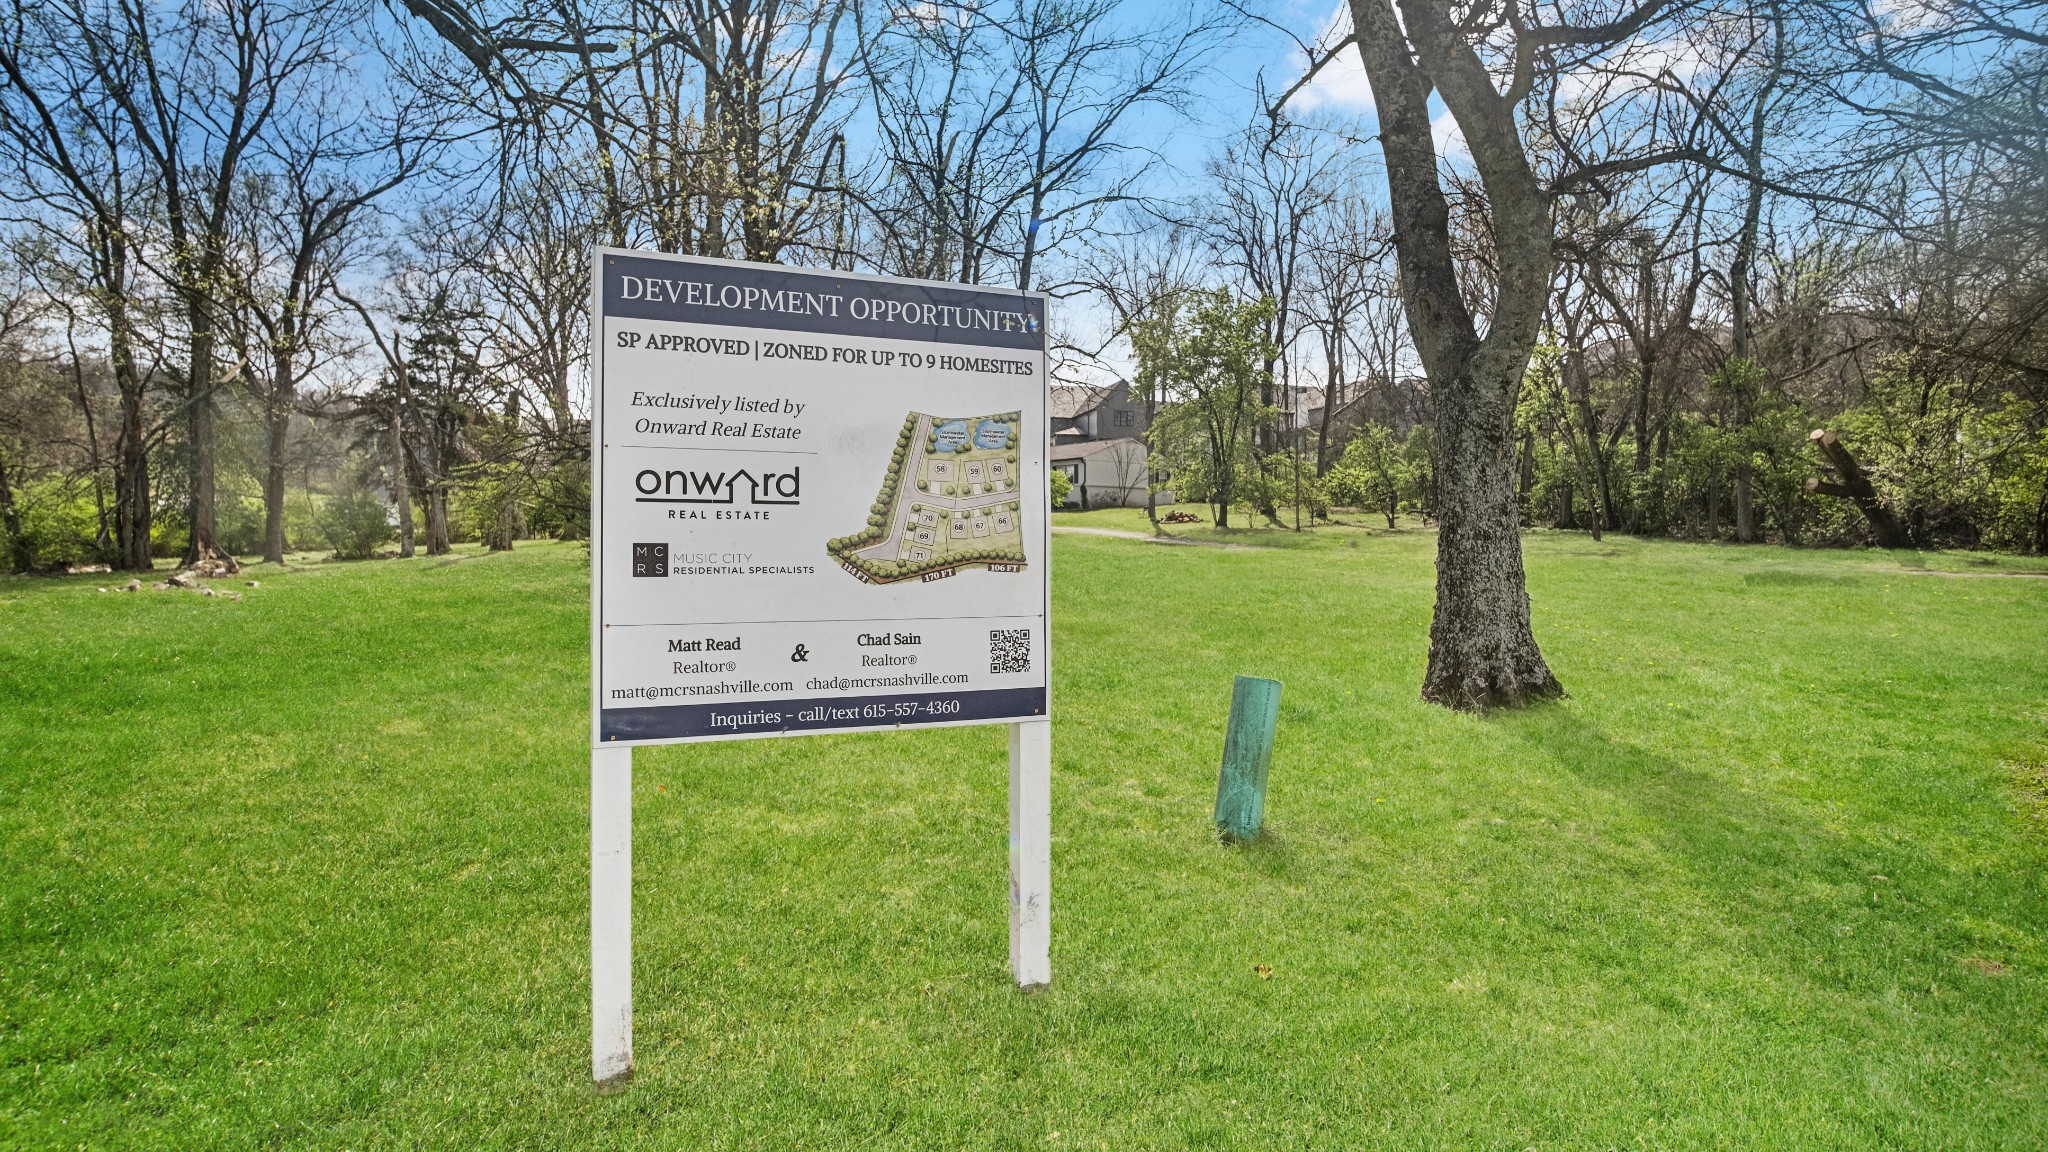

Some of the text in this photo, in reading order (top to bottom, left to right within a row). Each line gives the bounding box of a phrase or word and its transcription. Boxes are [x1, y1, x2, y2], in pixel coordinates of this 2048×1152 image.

[620, 275, 1032, 334] DEVELOPMENT OPPORTUNITY
[617, 331, 642, 349] SP
[645, 333, 750, 356] APPROVED
[763, 342, 828, 362] ZONED
[832, 347, 868, 365] FOR
[871, 350, 895, 366] UP
[899, 352, 922, 369] TO
[926, 354, 936, 369] 9
[939, 355, 1034, 376] HOMESITES
[631, 391, 805, 419] Exclusively listed by
[635, 417, 802, 441] Onward Real Estate
[936, 465, 946, 473] 58
[993, 465, 1002, 473] 60
[668, 509, 770, 520] REAL ESTATE
[924, 514, 934, 522] 70
[954, 523, 964, 531] 68
[975, 521, 985, 529] 67
[998, 517, 1007, 525] 66
[919, 532, 929, 540] 69
[673, 552, 753, 564] MUSIC CITY
[915, 551, 924, 560] 71
[673, 565, 815, 575] RESIDENTIAL SPECIALISTS
[990, 564, 1019, 573] 106 FT
[854, 571, 869, 583] FT
[924, 568, 954, 583] 170 FT
[668, 637, 741, 652] Matt Read
[857, 632, 921, 647] Chad Sain
[791, 643, 809, 663] &
[806, 672, 969, 691] chad@mcrsnashville.com
[611, 679, 793, 700] matt@mcrsnashville.com
[710, 710, 781, 729] Inquiries
[798, 706, 860, 723] call/text
[863, 700, 960, 718] 615-557-4360
